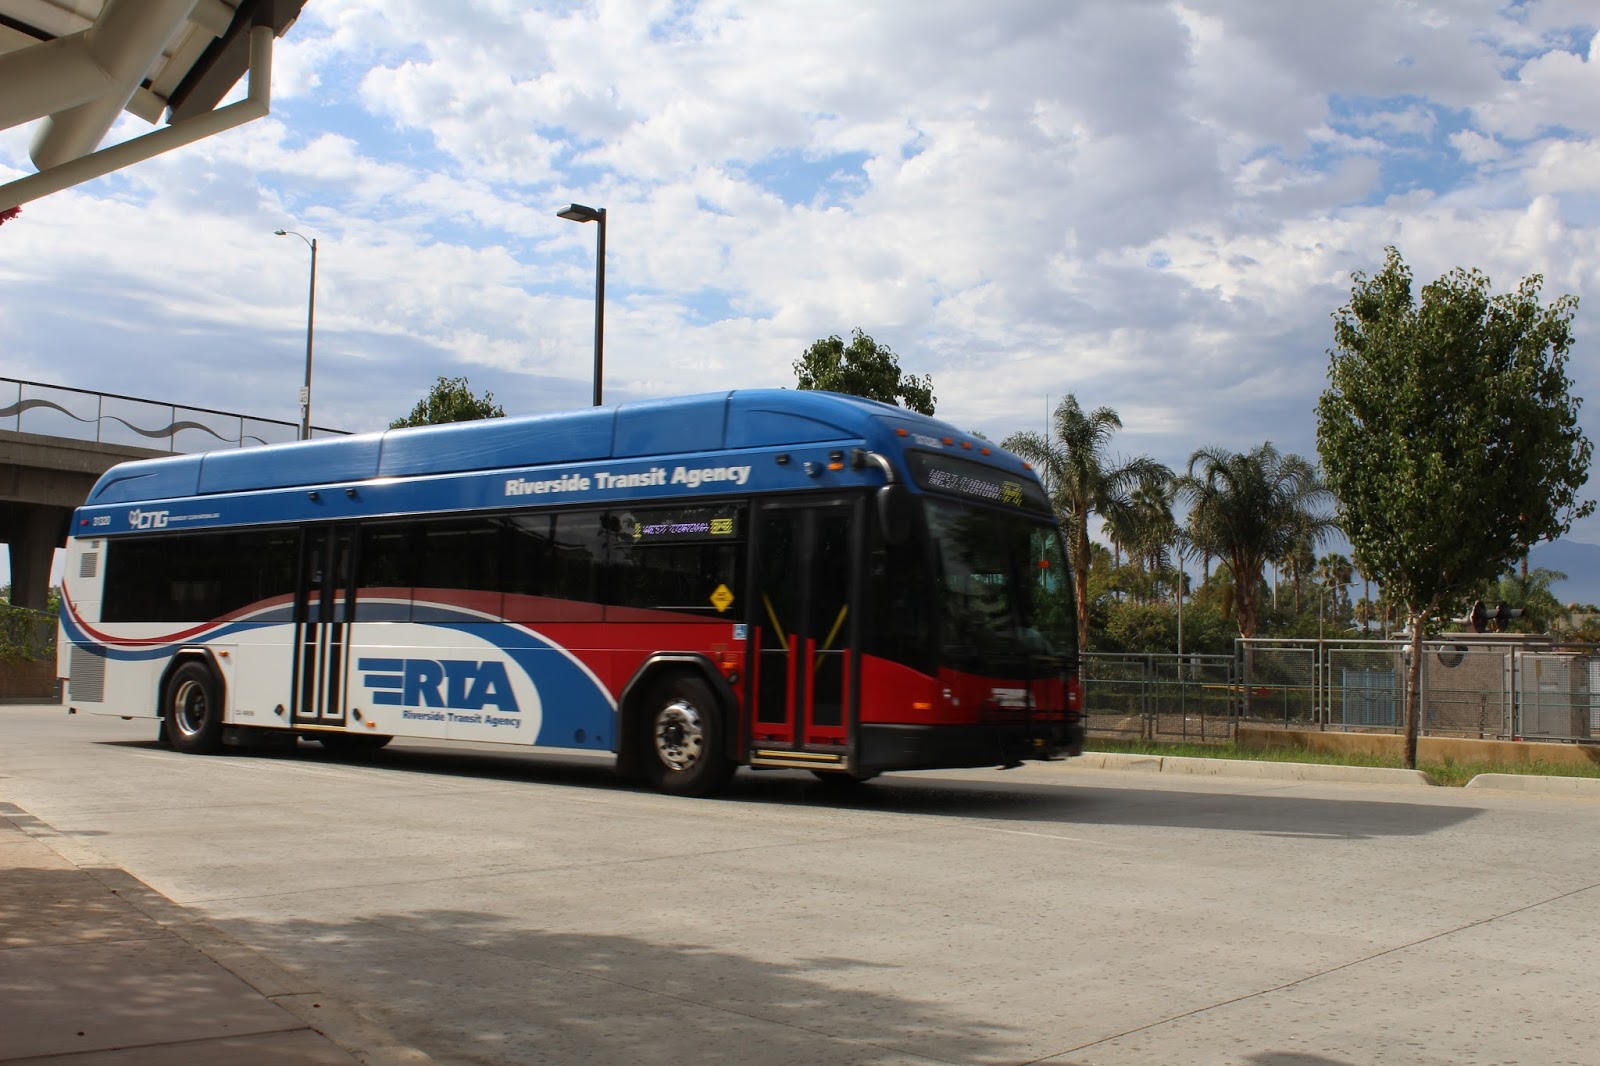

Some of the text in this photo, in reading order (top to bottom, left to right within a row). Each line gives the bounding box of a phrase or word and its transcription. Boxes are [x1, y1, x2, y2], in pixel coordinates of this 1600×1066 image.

[505, 465, 752, 496] Riverside Transit Agency
[404, 658, 521, 712] RTA
[403, 710, 522, 729] Riverside Transit Agency
